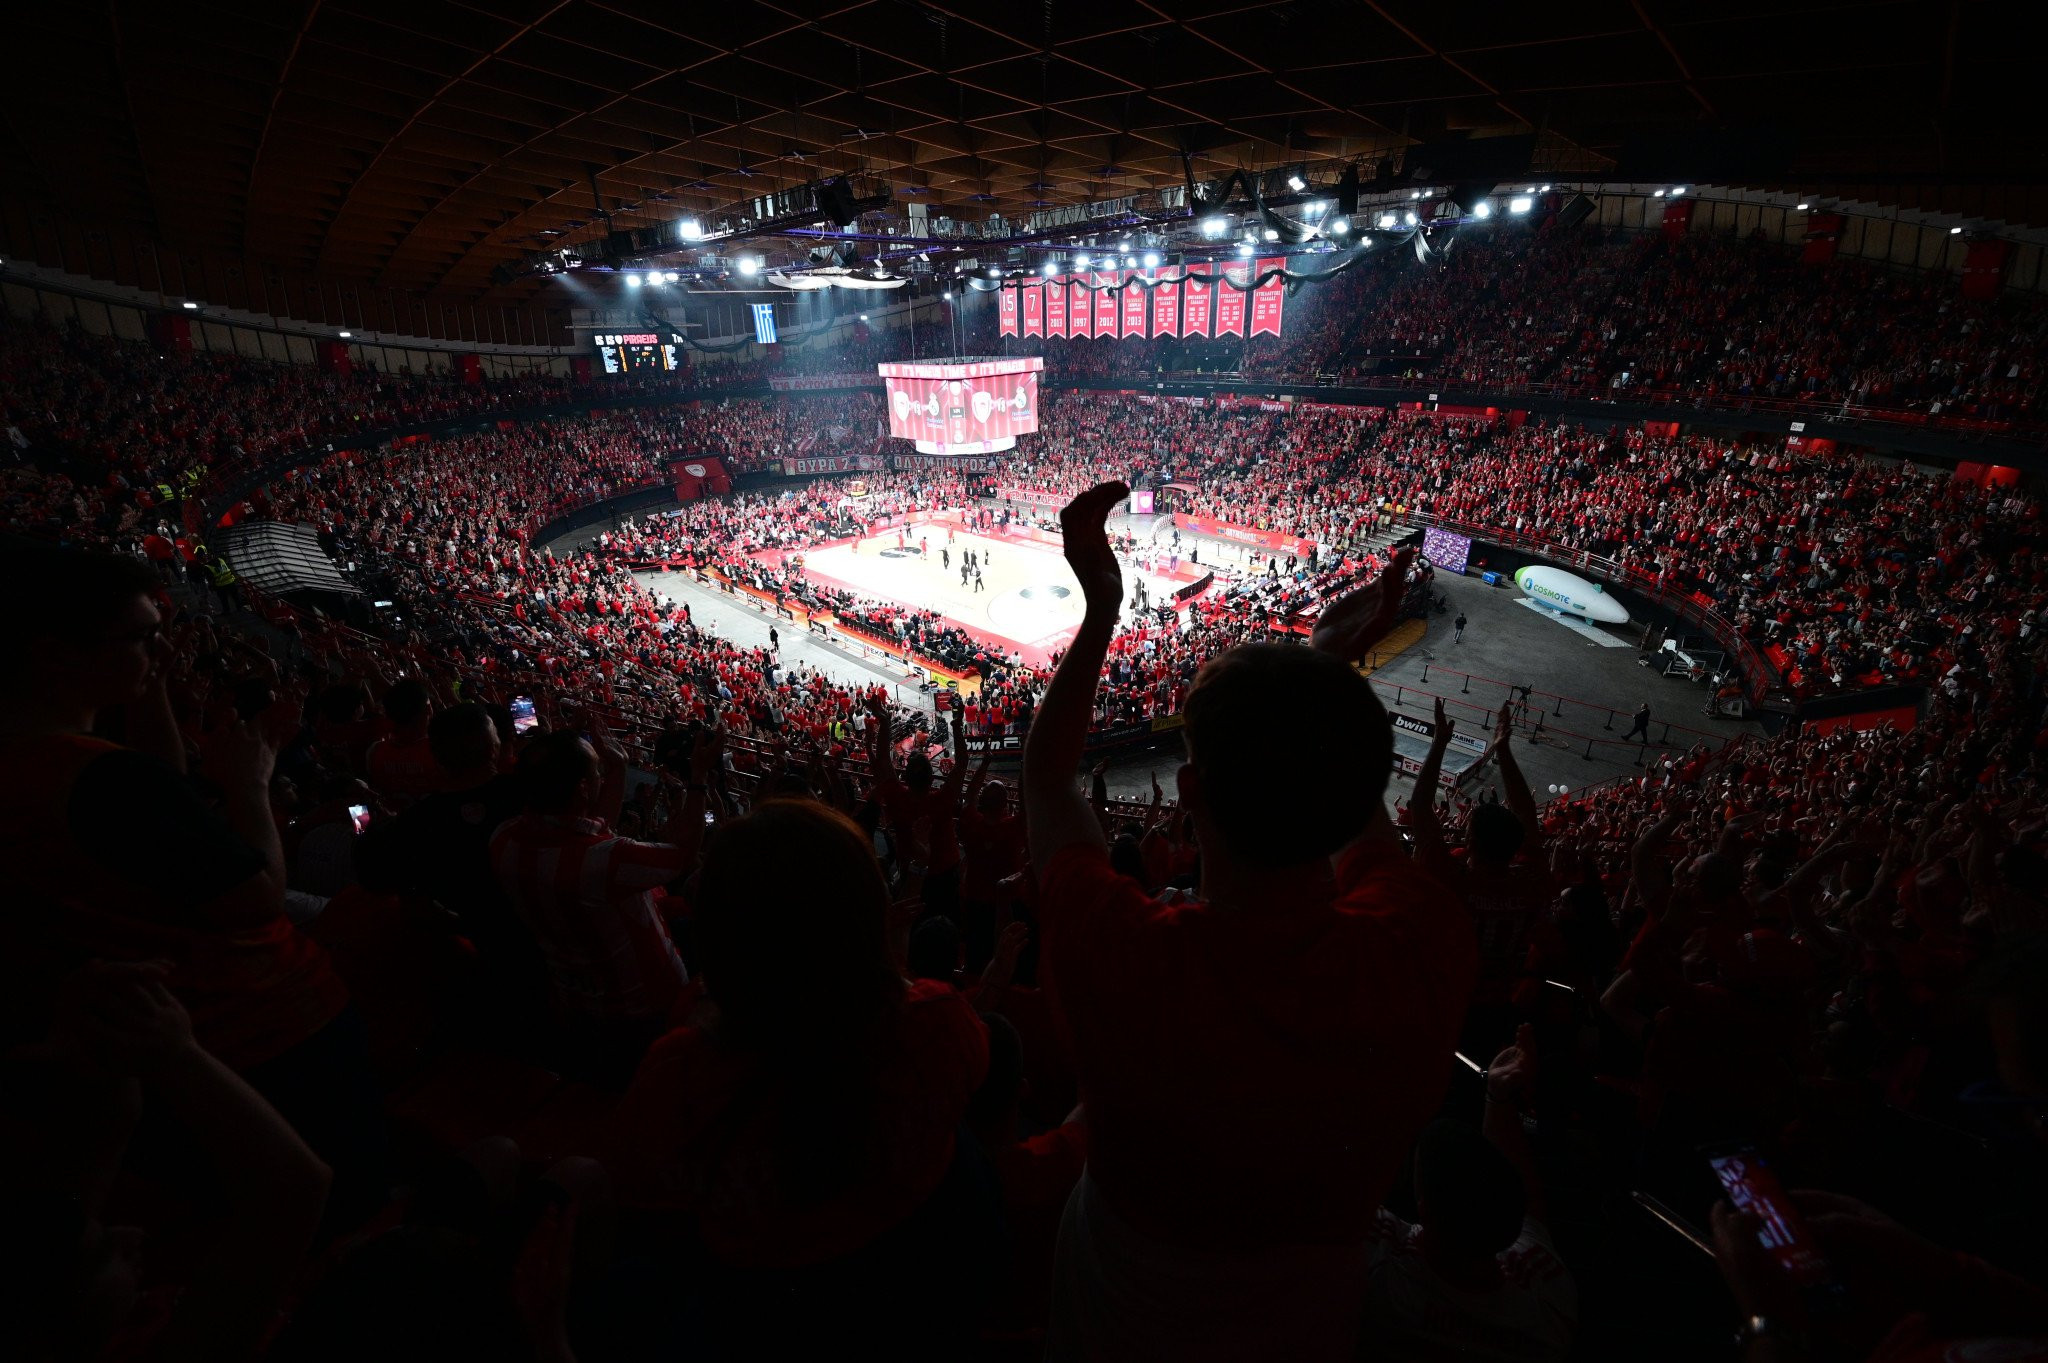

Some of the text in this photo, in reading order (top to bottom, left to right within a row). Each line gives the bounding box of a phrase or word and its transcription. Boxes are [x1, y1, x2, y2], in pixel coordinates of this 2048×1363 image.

[1002, 294, 1014, 312] 15
[1028, 293, 1037, 312] 7
[1073, 317, 1087, 327] 1997
[1099, 317, 1114, 327] 2012
[1126, 316, 1142, 326] 2013
[623, 335, 658, 345] PIRAEUS
[1260, 401, 1285, 412] bwin
[1533, 584, 1570, 604] COSMOTE
[869, 646, 885, 659] EKO
[1395, 716, 1428, 734] bwin
